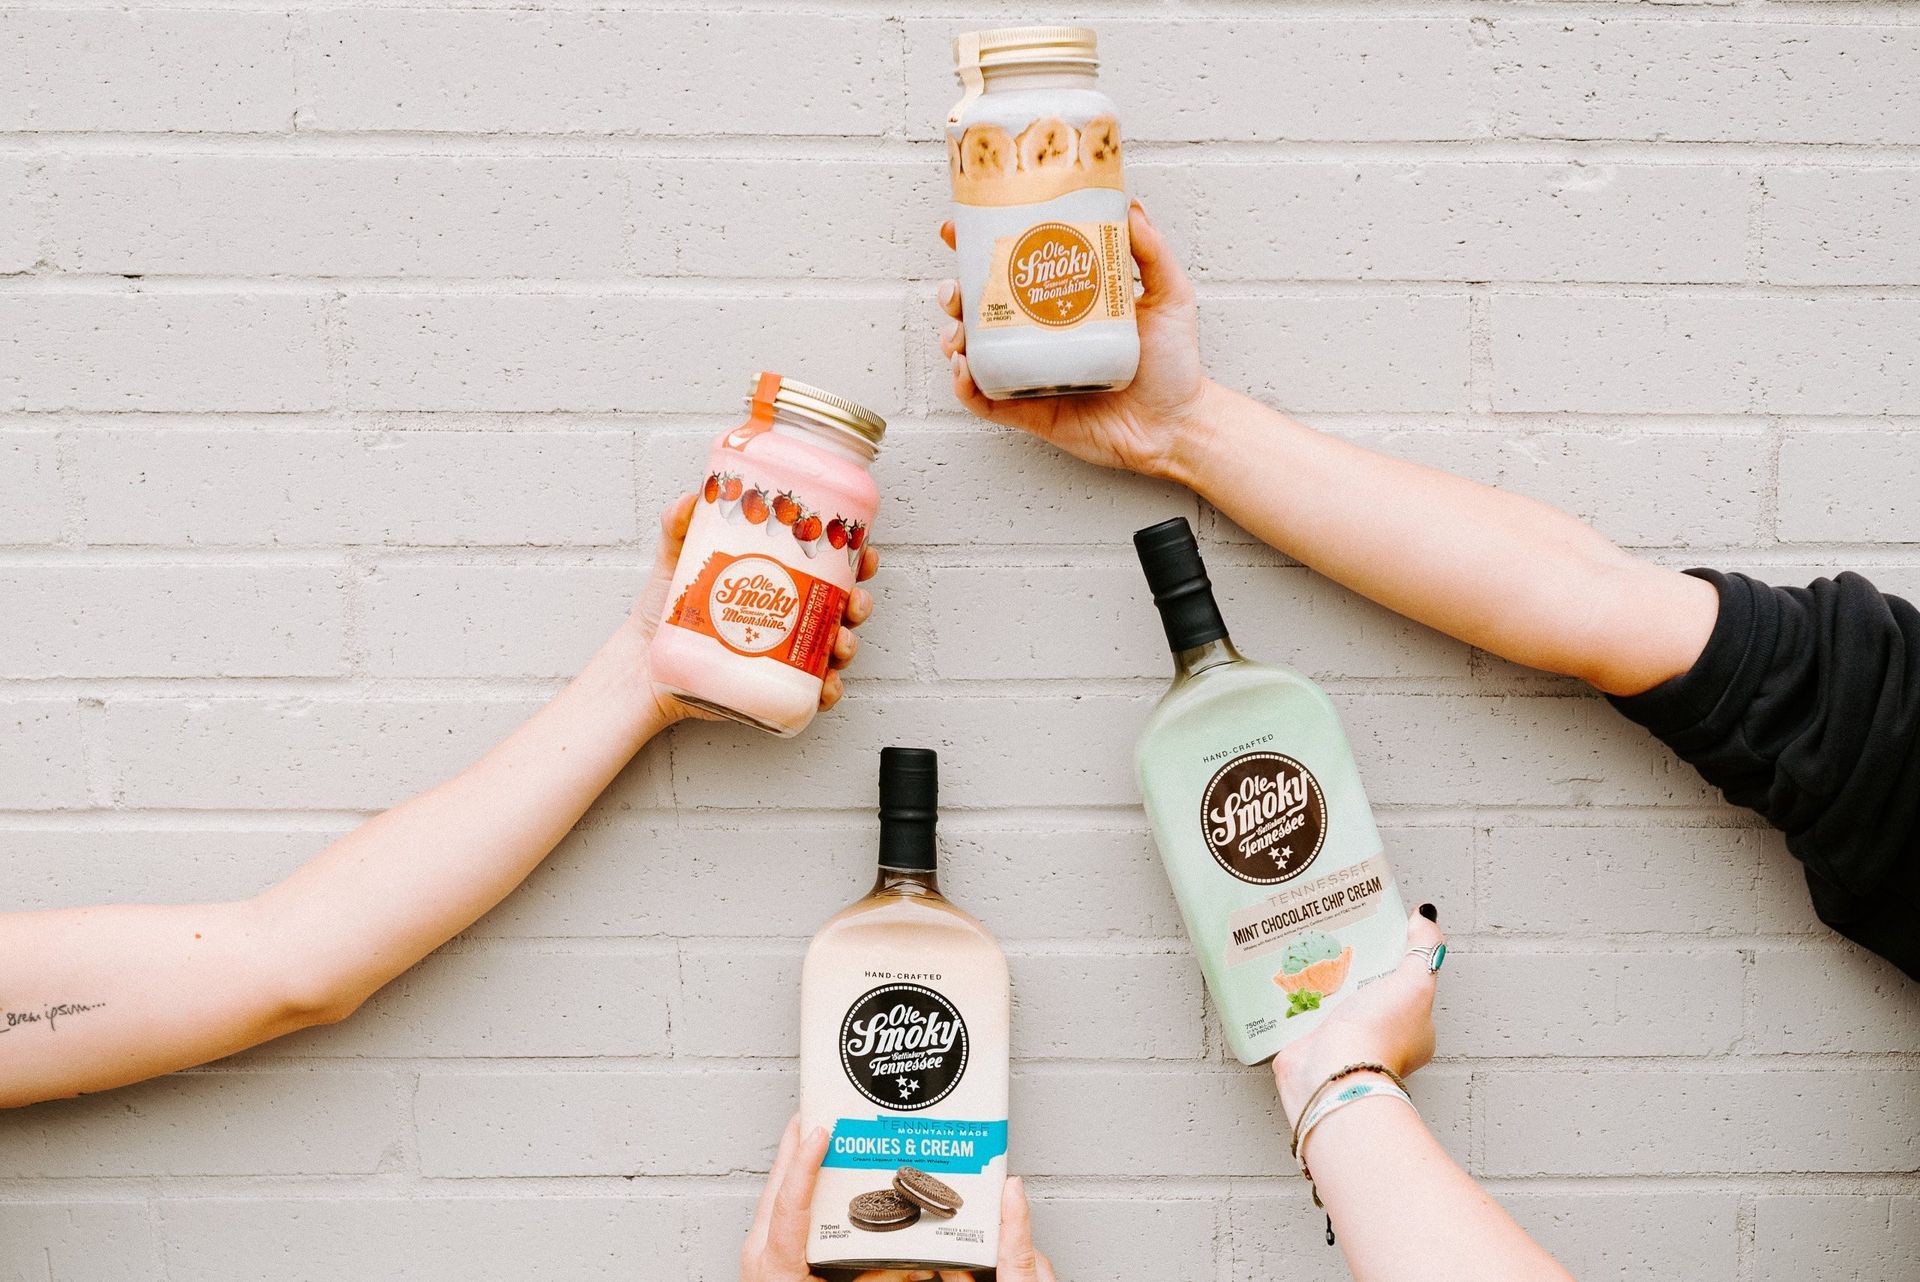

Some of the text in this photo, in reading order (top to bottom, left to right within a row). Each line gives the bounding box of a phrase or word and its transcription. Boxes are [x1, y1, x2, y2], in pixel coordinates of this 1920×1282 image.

[1042, 240, 1070, 261] Ole
[1014, 245, 1096, 288] Smoky
[1103, 224, 1120, 317] BANANA PUDDING
[1027, 279, 1096, 305] Moonshine
[987, 303, 1008, 311] 750ml
[750, 574, 776, 594] Ole
[715, 577, 798, 619] Smoky
[722, 607, 787, 632] Moonshine
[790, 583, 820, 662] WHITE CHOCOLATE
[796, 583, 830, 668] STRAWBERRY CREAM
[1202, 733, 1275, 764] HAND-CRAFTED
[1239, 774, 1276, 802] Ole
[1210, 769, 1309, 846] Smoky
[1238, 813, 1305, 859] Tennessee
[1268, 860, 1371, 908] TENNESSEE
[1232, 876, 1383, 946] MINT CHOCOLATE CHIP CREAM
[864, 970, 942, 981] HAND-CRAFTED
[0, 1012, 41, 1033] orem
[888, 1003, 927, 1026] Ole
[1244, 1017, 1265, 1030] 750ml
[846, 1011, 962, 1057] Smoky
[868, 1055, 943, 1077] Tennessee
[880, 1119, 990, 1132] TENNESSEE
[897, 1128, 955, 1136] MOUNTAIN
[834, 1136, 975, 1158] COOKIES & CREAM
